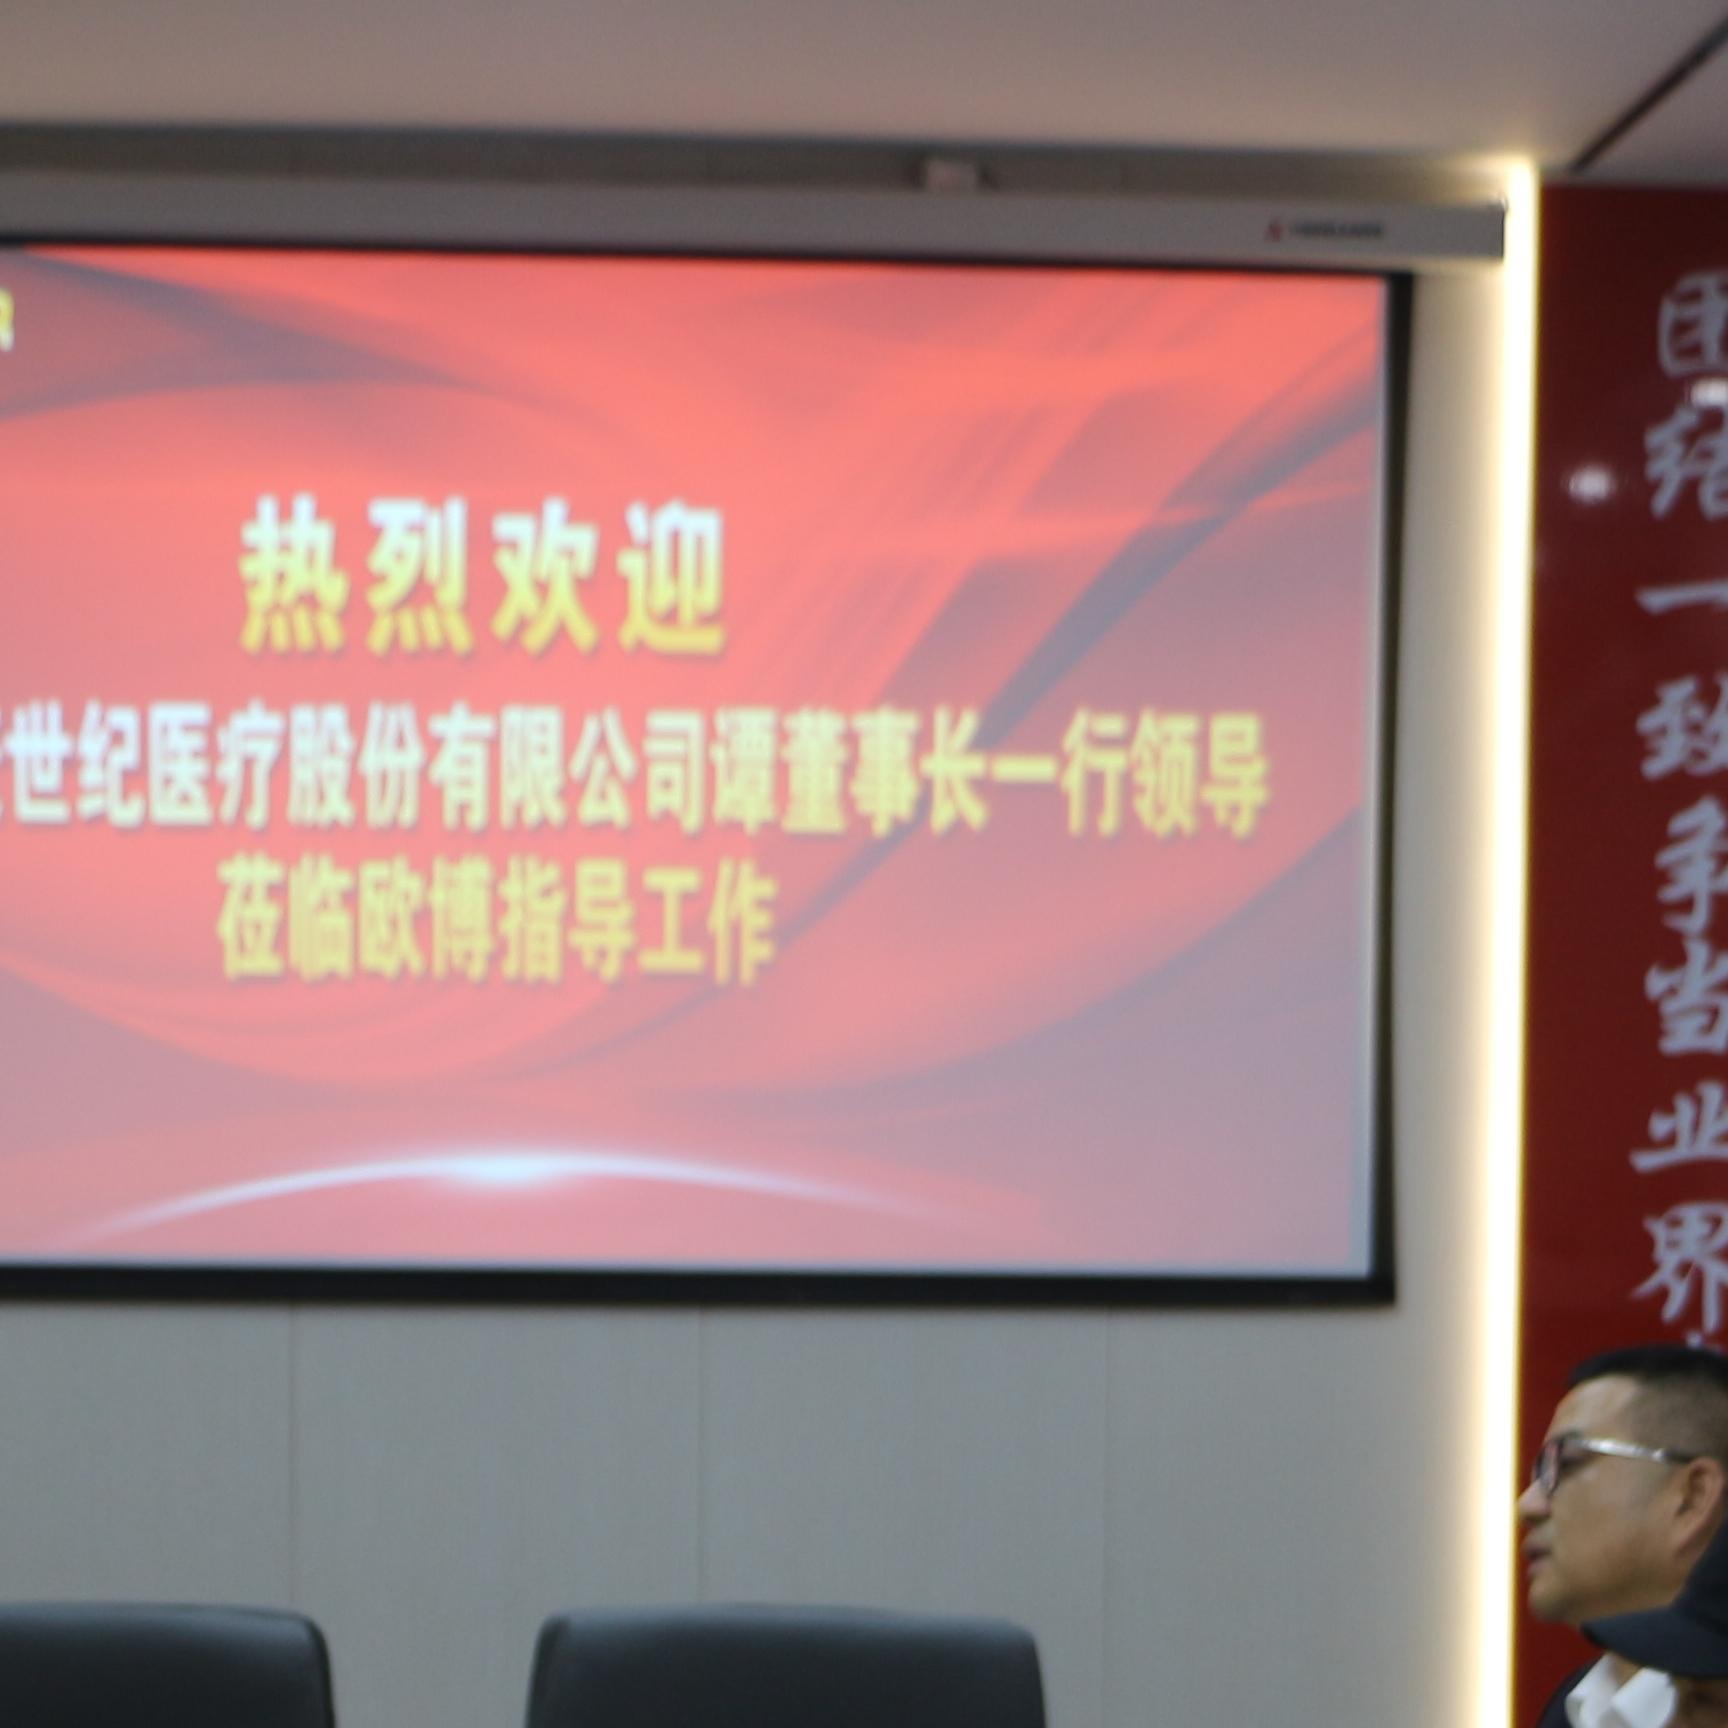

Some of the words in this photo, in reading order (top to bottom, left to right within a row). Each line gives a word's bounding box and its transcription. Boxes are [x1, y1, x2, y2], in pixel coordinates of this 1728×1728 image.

[237, 492, 728, 658] 热烈欢迎
[216, 850, 778, 986] 莅临欧博指导工作
